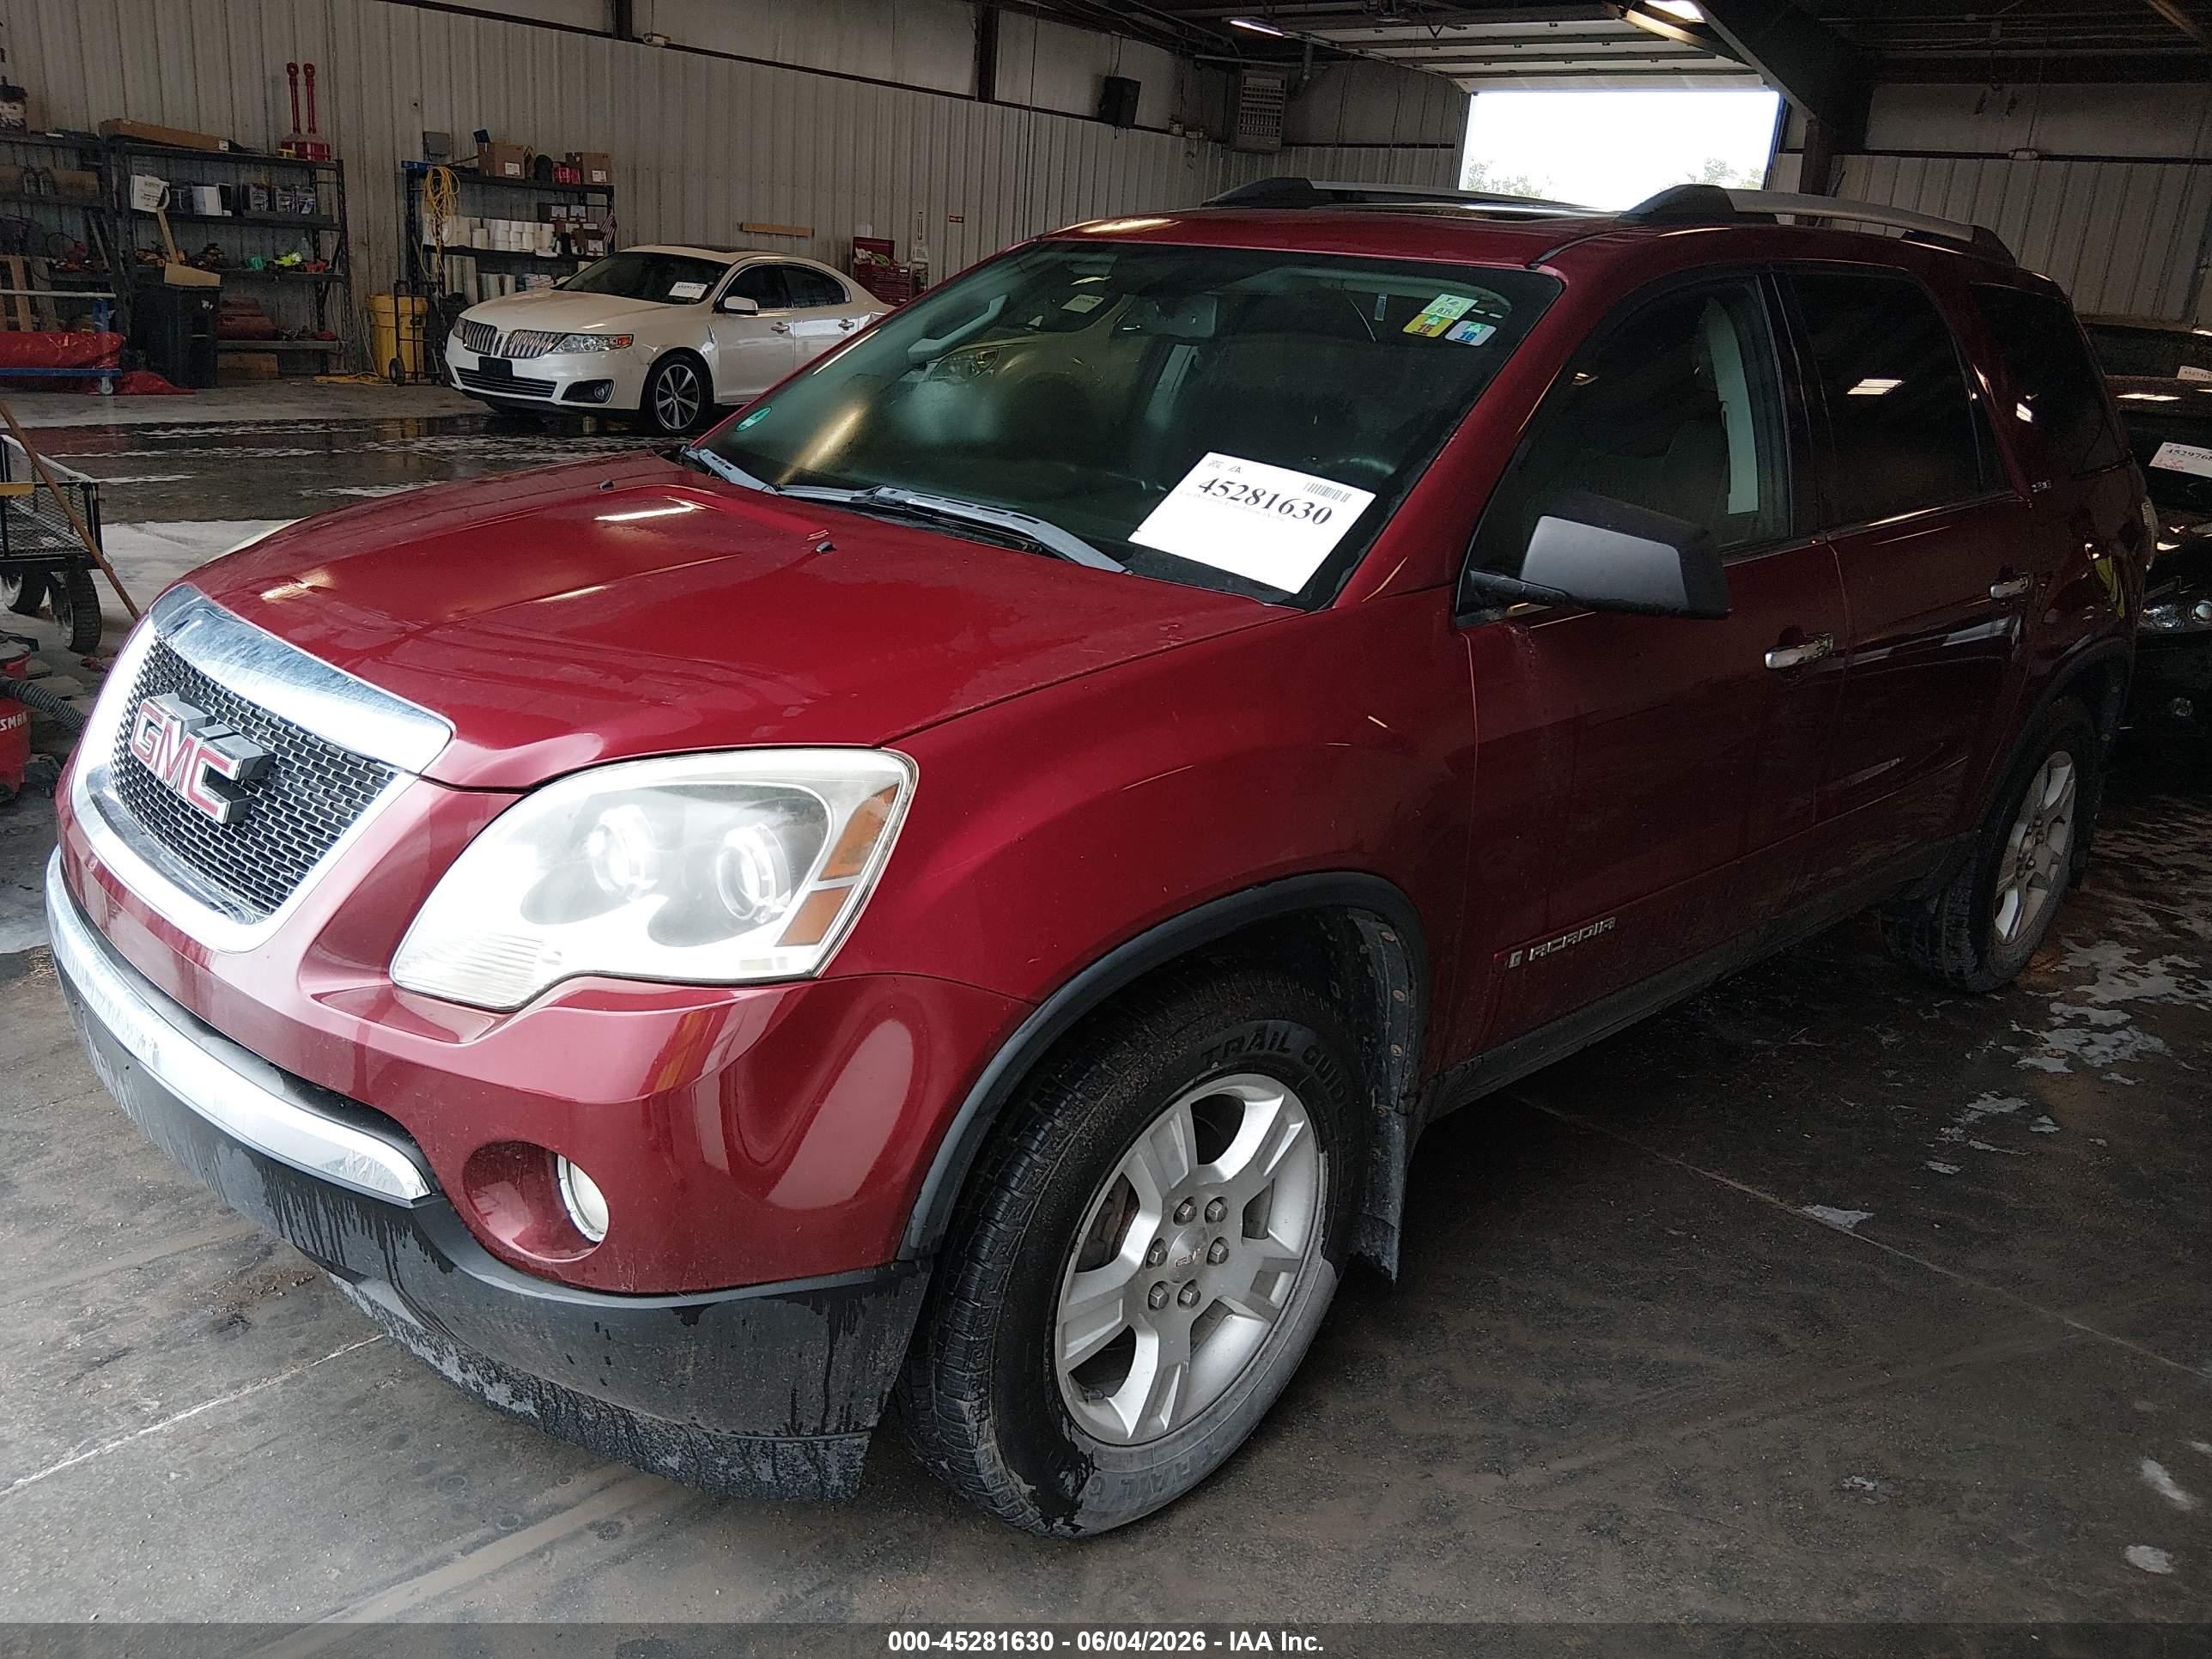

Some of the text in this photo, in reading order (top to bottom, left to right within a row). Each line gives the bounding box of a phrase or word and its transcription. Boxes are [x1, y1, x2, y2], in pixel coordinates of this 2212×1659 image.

[1198, 477, 1333, 526] 45281630
[131, 697, 244, 824] GMC
[1528, 916, 1616, 962] ACADIA
